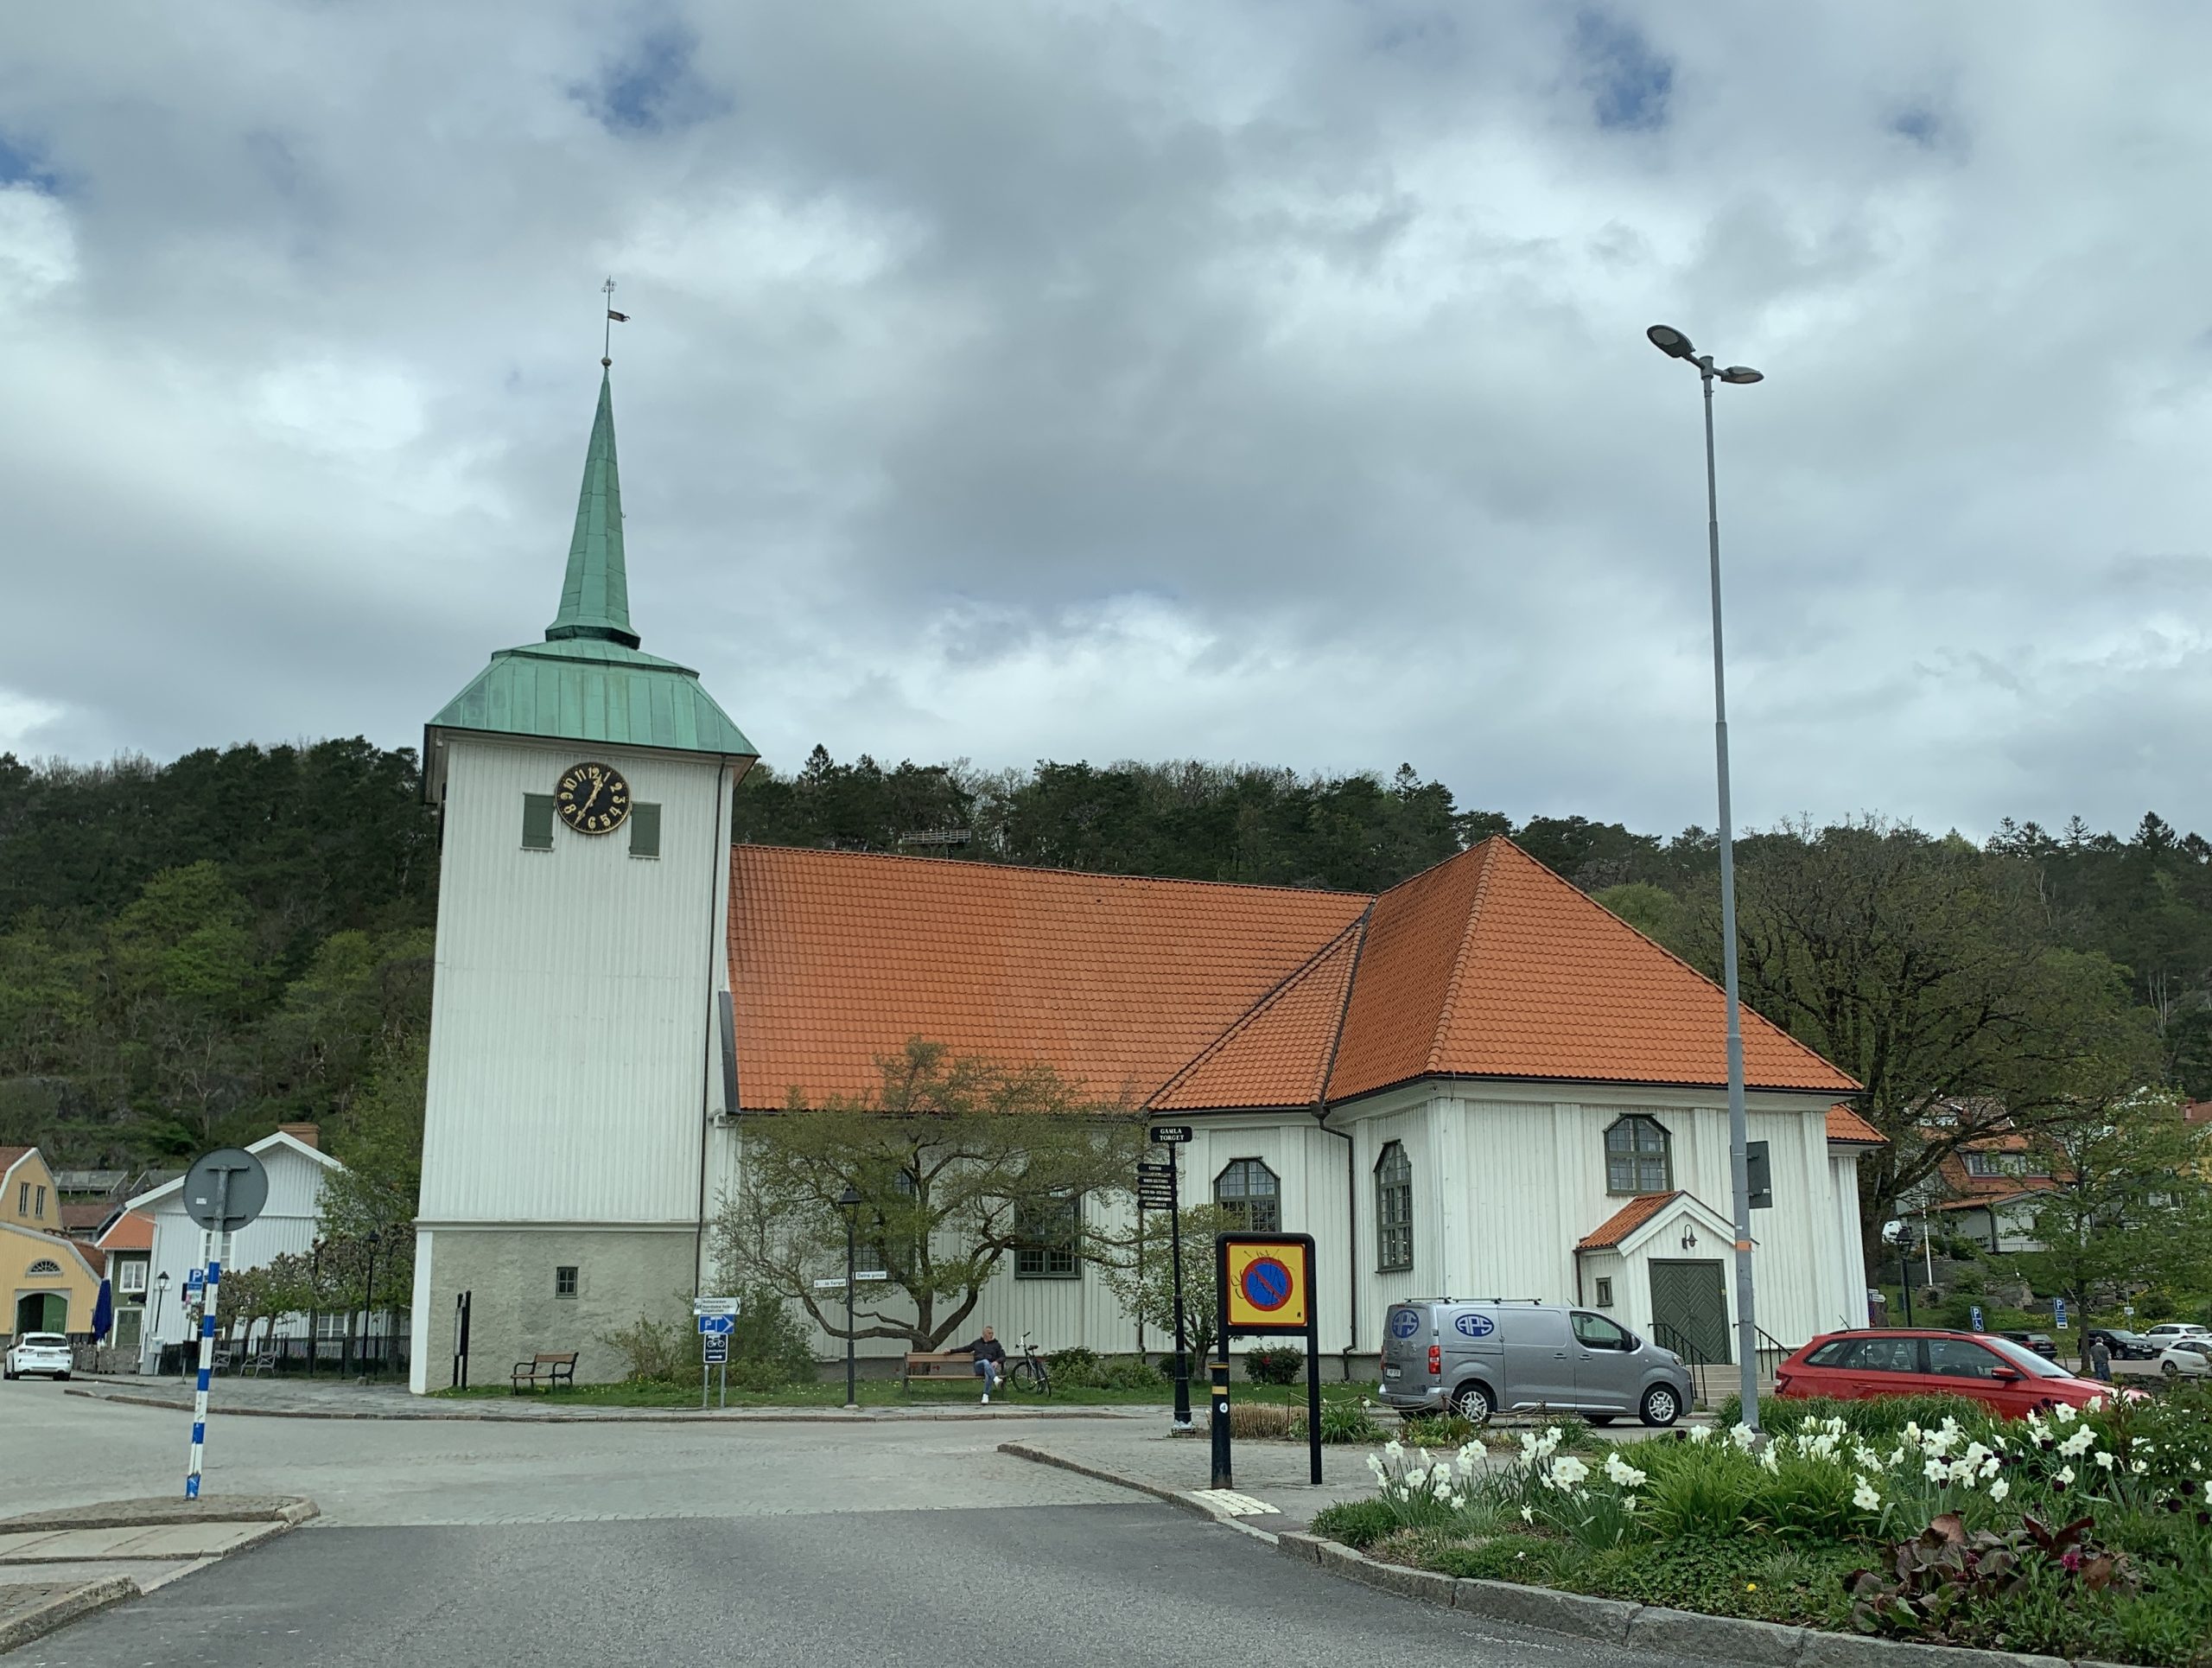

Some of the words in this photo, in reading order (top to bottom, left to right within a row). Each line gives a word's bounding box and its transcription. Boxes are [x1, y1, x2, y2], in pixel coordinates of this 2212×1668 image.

[575, 768, 587, 782] 11
[588, 767, 601, 780] 12
[603, 772, 611, 782] 1
[563, 778, 577, 791] 10
[610, 782, 622, 793] 2
[560, 792, 574, 800] 9
[612, 795, 626, 804] 3
[563, 804, 576, 814] 8
[609, 805, 622, 817] 4
[588, 816, 596, 829] 6
[600, 812, 611, 827] 5
[192, 1270, 201, 1282] P
[2056, 1299, 2063, 1308] P
[1973, 1308, 1980, 1318] P
[704, 1320, 712, 1329] P
[1393, 1311, 1418, 1336] APS
[1456, 1315, 1493, 1335] APS
